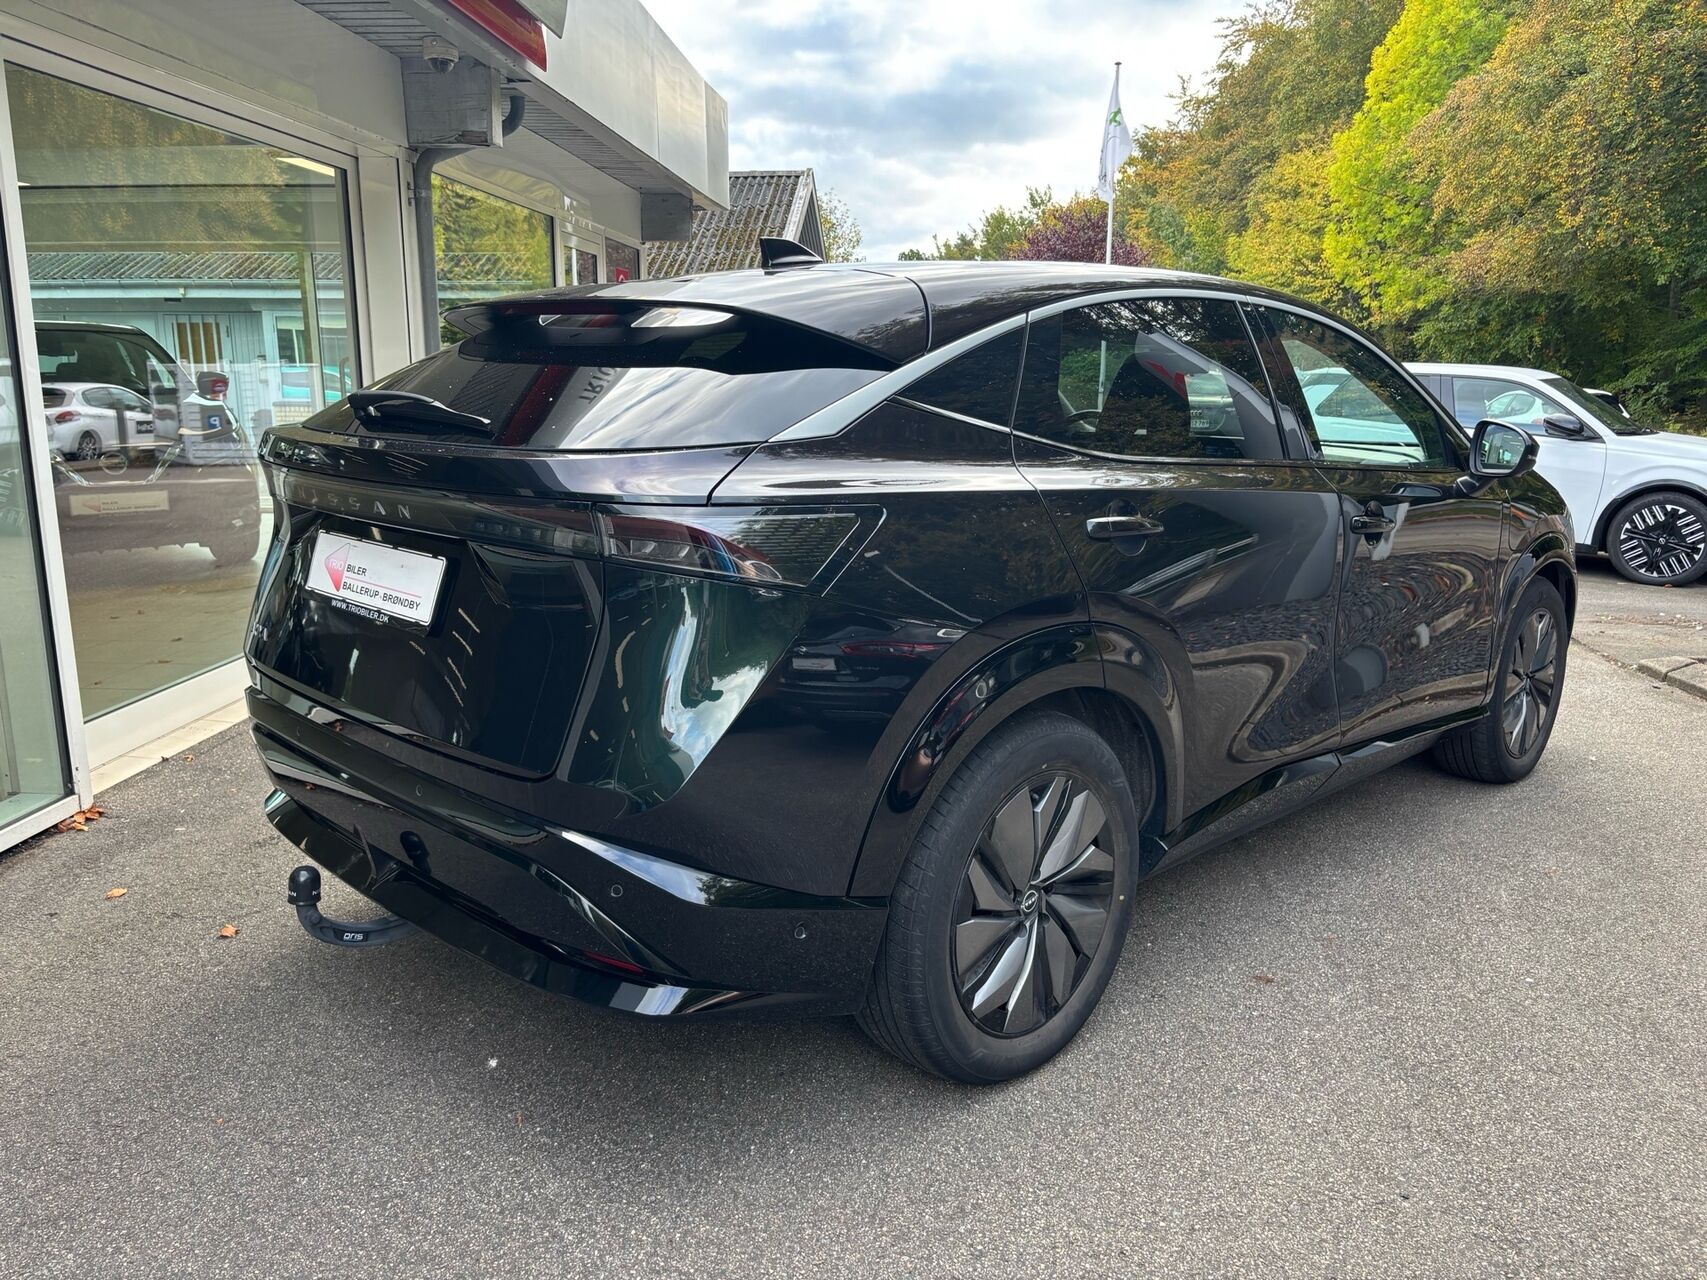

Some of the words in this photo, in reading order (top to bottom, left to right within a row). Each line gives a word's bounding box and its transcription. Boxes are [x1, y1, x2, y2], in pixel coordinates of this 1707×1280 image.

[296, 486, 412, 520] NISSAN
[346, 563, 368, 577] BILER
[342, 581, 380, 599] BALLERUP
[382, 592, 421, 611] BRØNDBY
[331, 598, 390, 623] WWW.TRIOBILER.DK
